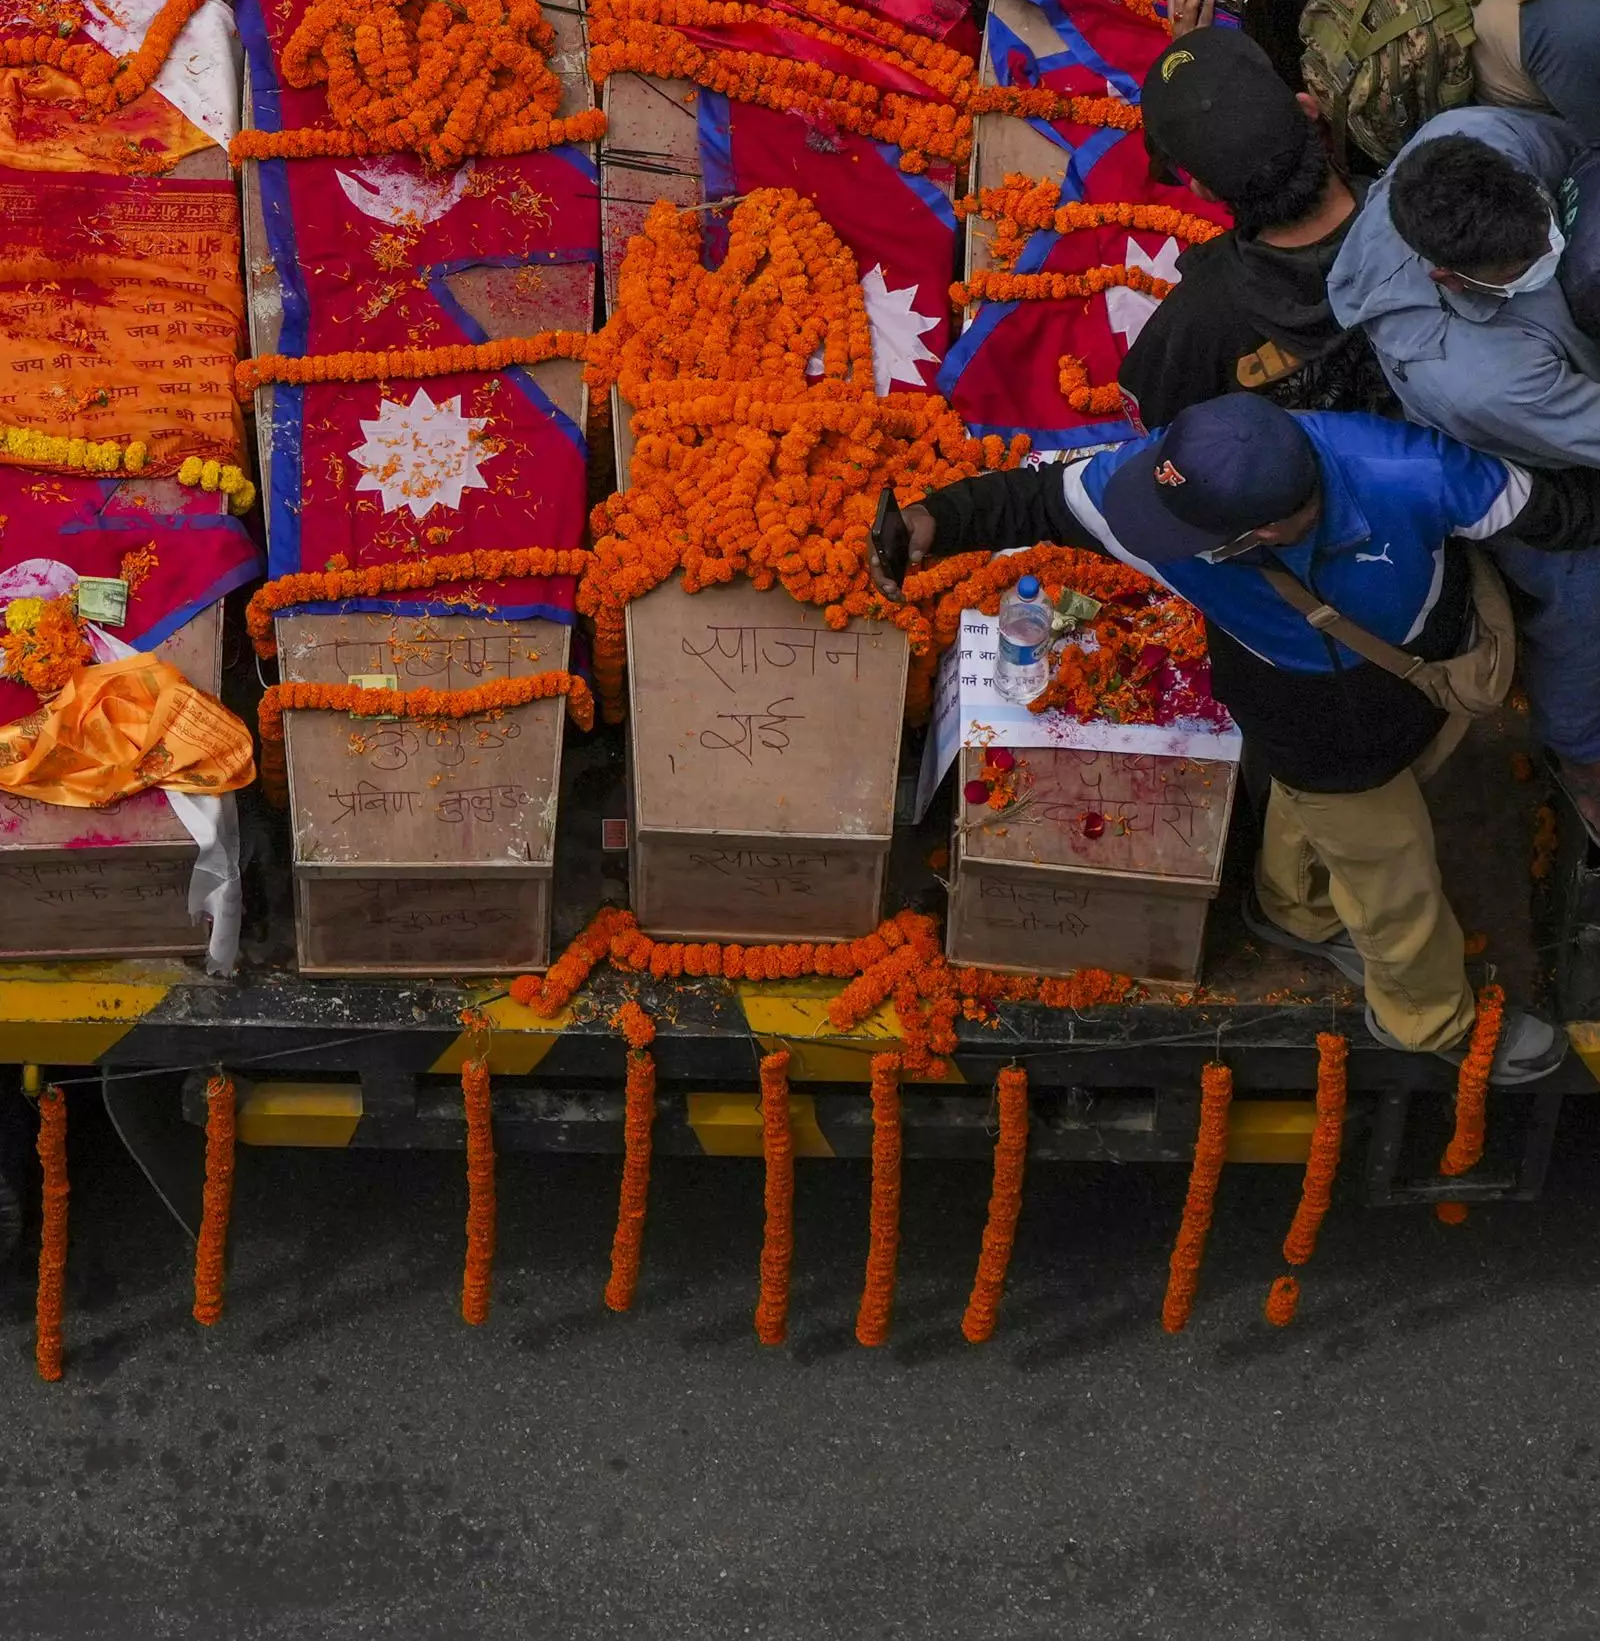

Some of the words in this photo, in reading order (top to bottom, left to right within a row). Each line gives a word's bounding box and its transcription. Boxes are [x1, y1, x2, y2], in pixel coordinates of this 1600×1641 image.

[127, 325, 161, 338] जय
[168, 320, 188, 336] श्री
[11, 358, 46, 373] जय
[52, 354, 73, 369] श्री
[172, 356, 193, 369] श्री
[159, 383, 191, 395] जय
[200, 383, 221, 394] श्री
[963, 624, 989, 635] लागी
[681, 625, 883, 693] साजन
[962, 674, 978, 686] गर्ने
